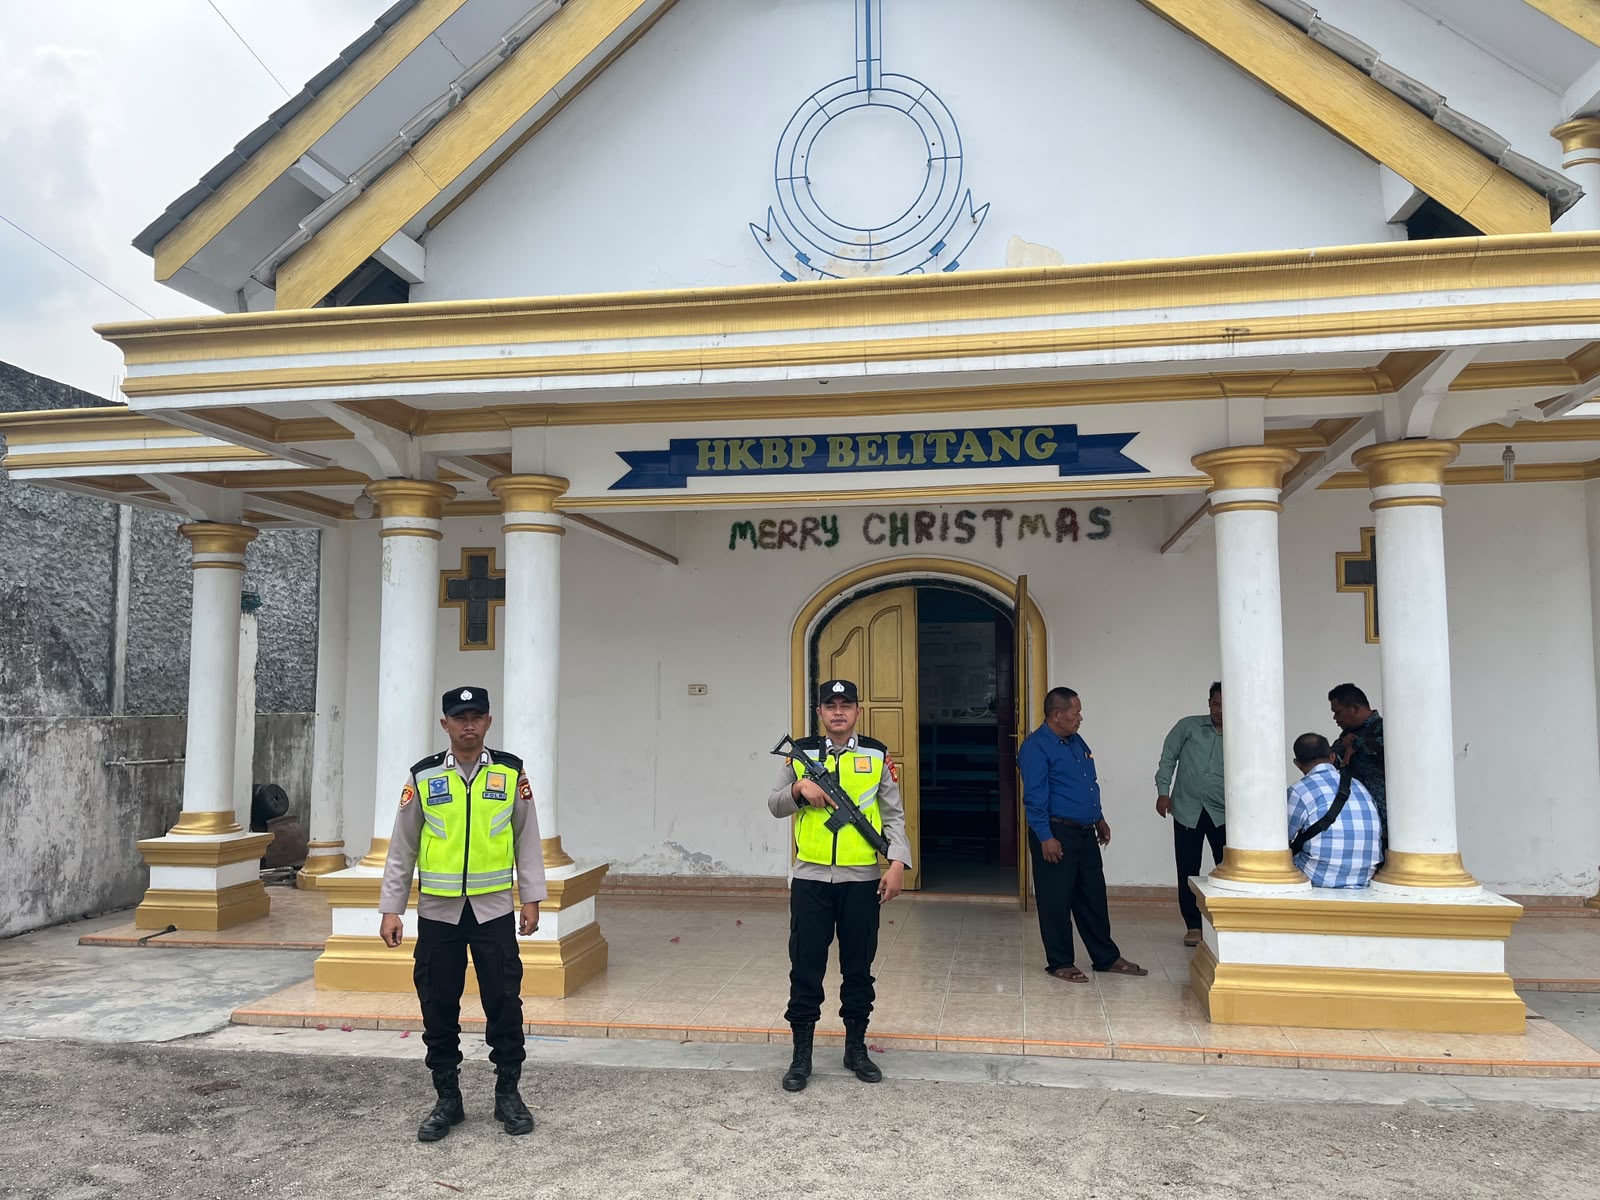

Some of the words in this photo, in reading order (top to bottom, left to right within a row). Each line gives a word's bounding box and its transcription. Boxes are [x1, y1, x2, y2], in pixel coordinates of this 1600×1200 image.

[696, 437, 817, 471] HKBP
[828, 427, 1058, 467] BELITANG
[729, 514, 840, 551] MERRY
[864, 506, 1112, 549] CHRISTMAS
